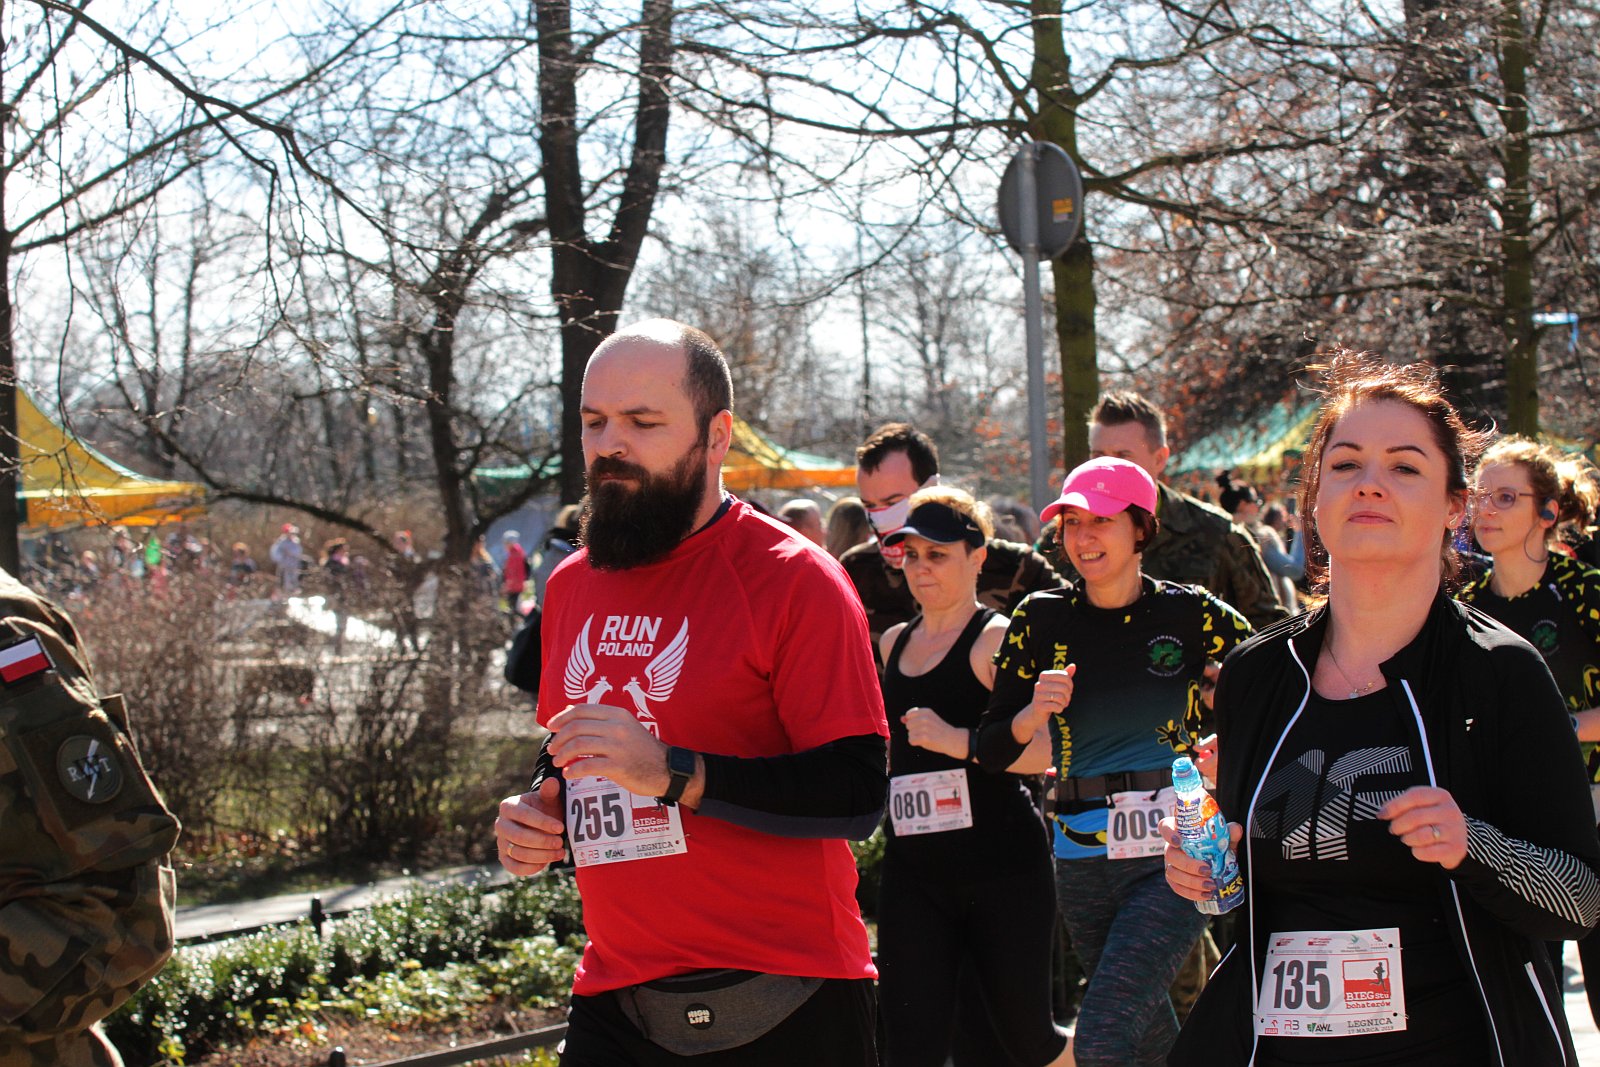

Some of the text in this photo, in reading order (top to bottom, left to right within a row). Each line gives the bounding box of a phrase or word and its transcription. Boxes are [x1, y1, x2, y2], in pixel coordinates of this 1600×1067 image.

[600, 615, 662, 642] RUN
[596, 642, 654, 657] POLAND
[894, 790, 931, 820] 080
[571, 793, 625, 843] 255
[1113, 808, 1165, 841] 009
[636, 841, 674, 852] LEGNICA
[1272, 959, 1331, 1010] 135
[1345, 991, 1374, 1001] BIEG
[1345, 1001, 1391, 1009] bohaterów
[689, 1015, 711, 1024] LIFE
[1346, 1017, 1393, 1028] LEGNICA
